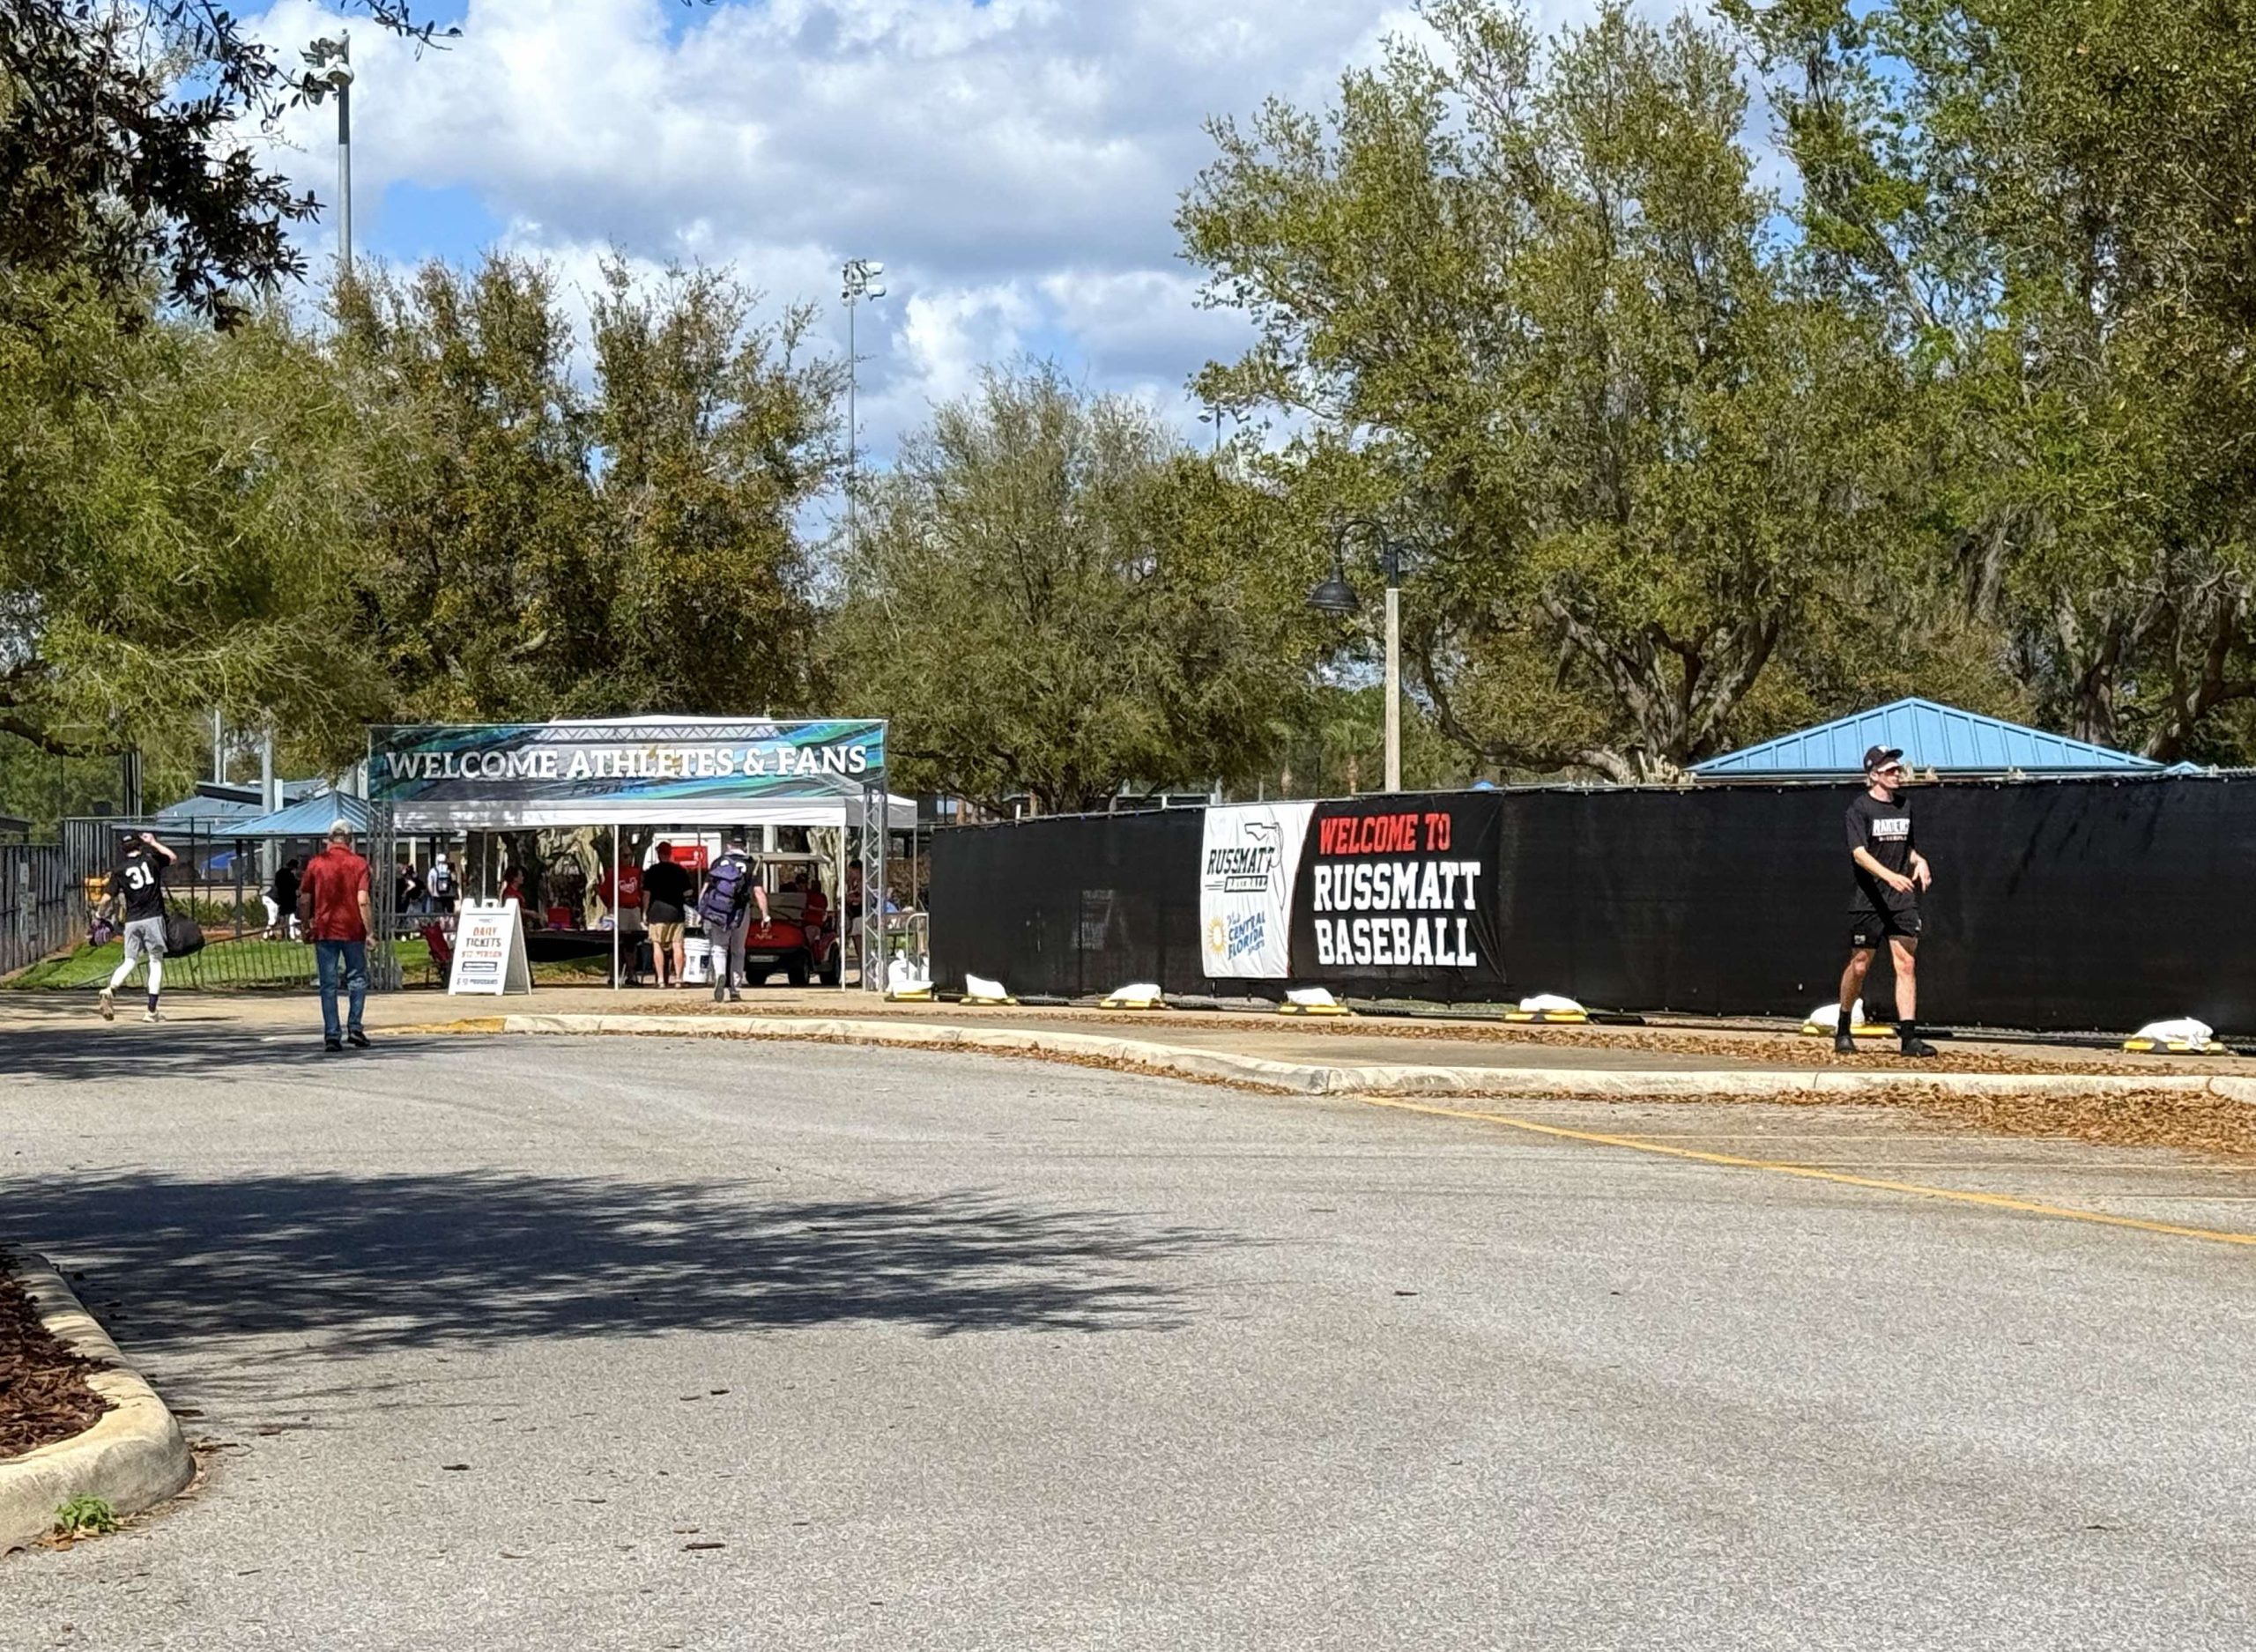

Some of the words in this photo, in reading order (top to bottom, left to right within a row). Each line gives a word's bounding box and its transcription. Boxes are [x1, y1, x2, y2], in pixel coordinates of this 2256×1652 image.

[386, 750, 558, 779] WELCOME
[568, 748, 734, 779] ATHLETES
[745, 747, 769, 775] &
[777, 745, 867, 775] FANS
[1319, 816, 1417, 854] WELCOME
[1426, 813, 1451, 851] TO
[125, 862, 154, 890] 31
[1206, 847, 1275, 875] RUSSMATT
[1314, 862, 1481, 911] RUSSMATT
[1228, 926, 1264, 960] FLORIDA
[1315, 917, 1477, 967] BASEBALL
